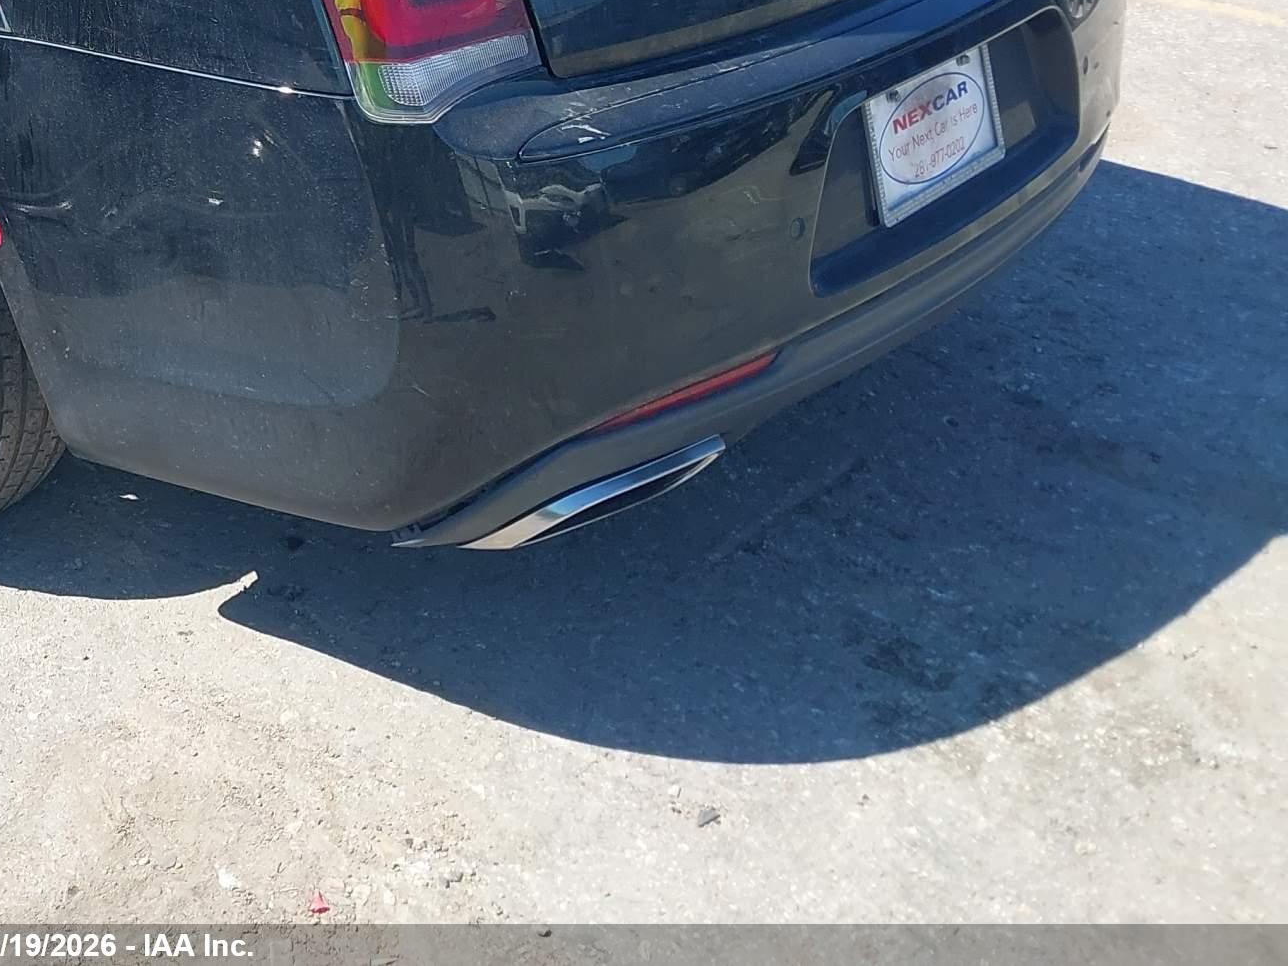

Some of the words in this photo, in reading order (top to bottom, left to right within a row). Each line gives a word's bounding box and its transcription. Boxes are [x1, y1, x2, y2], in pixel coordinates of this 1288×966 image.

[888, 142, 911, 162] Your
[913, 129, 933, 150] Next
[934, 119, 949, 136] Car
[960, 102, 978, 121] Here
[892, 81, 968, 134] NEXCAR
